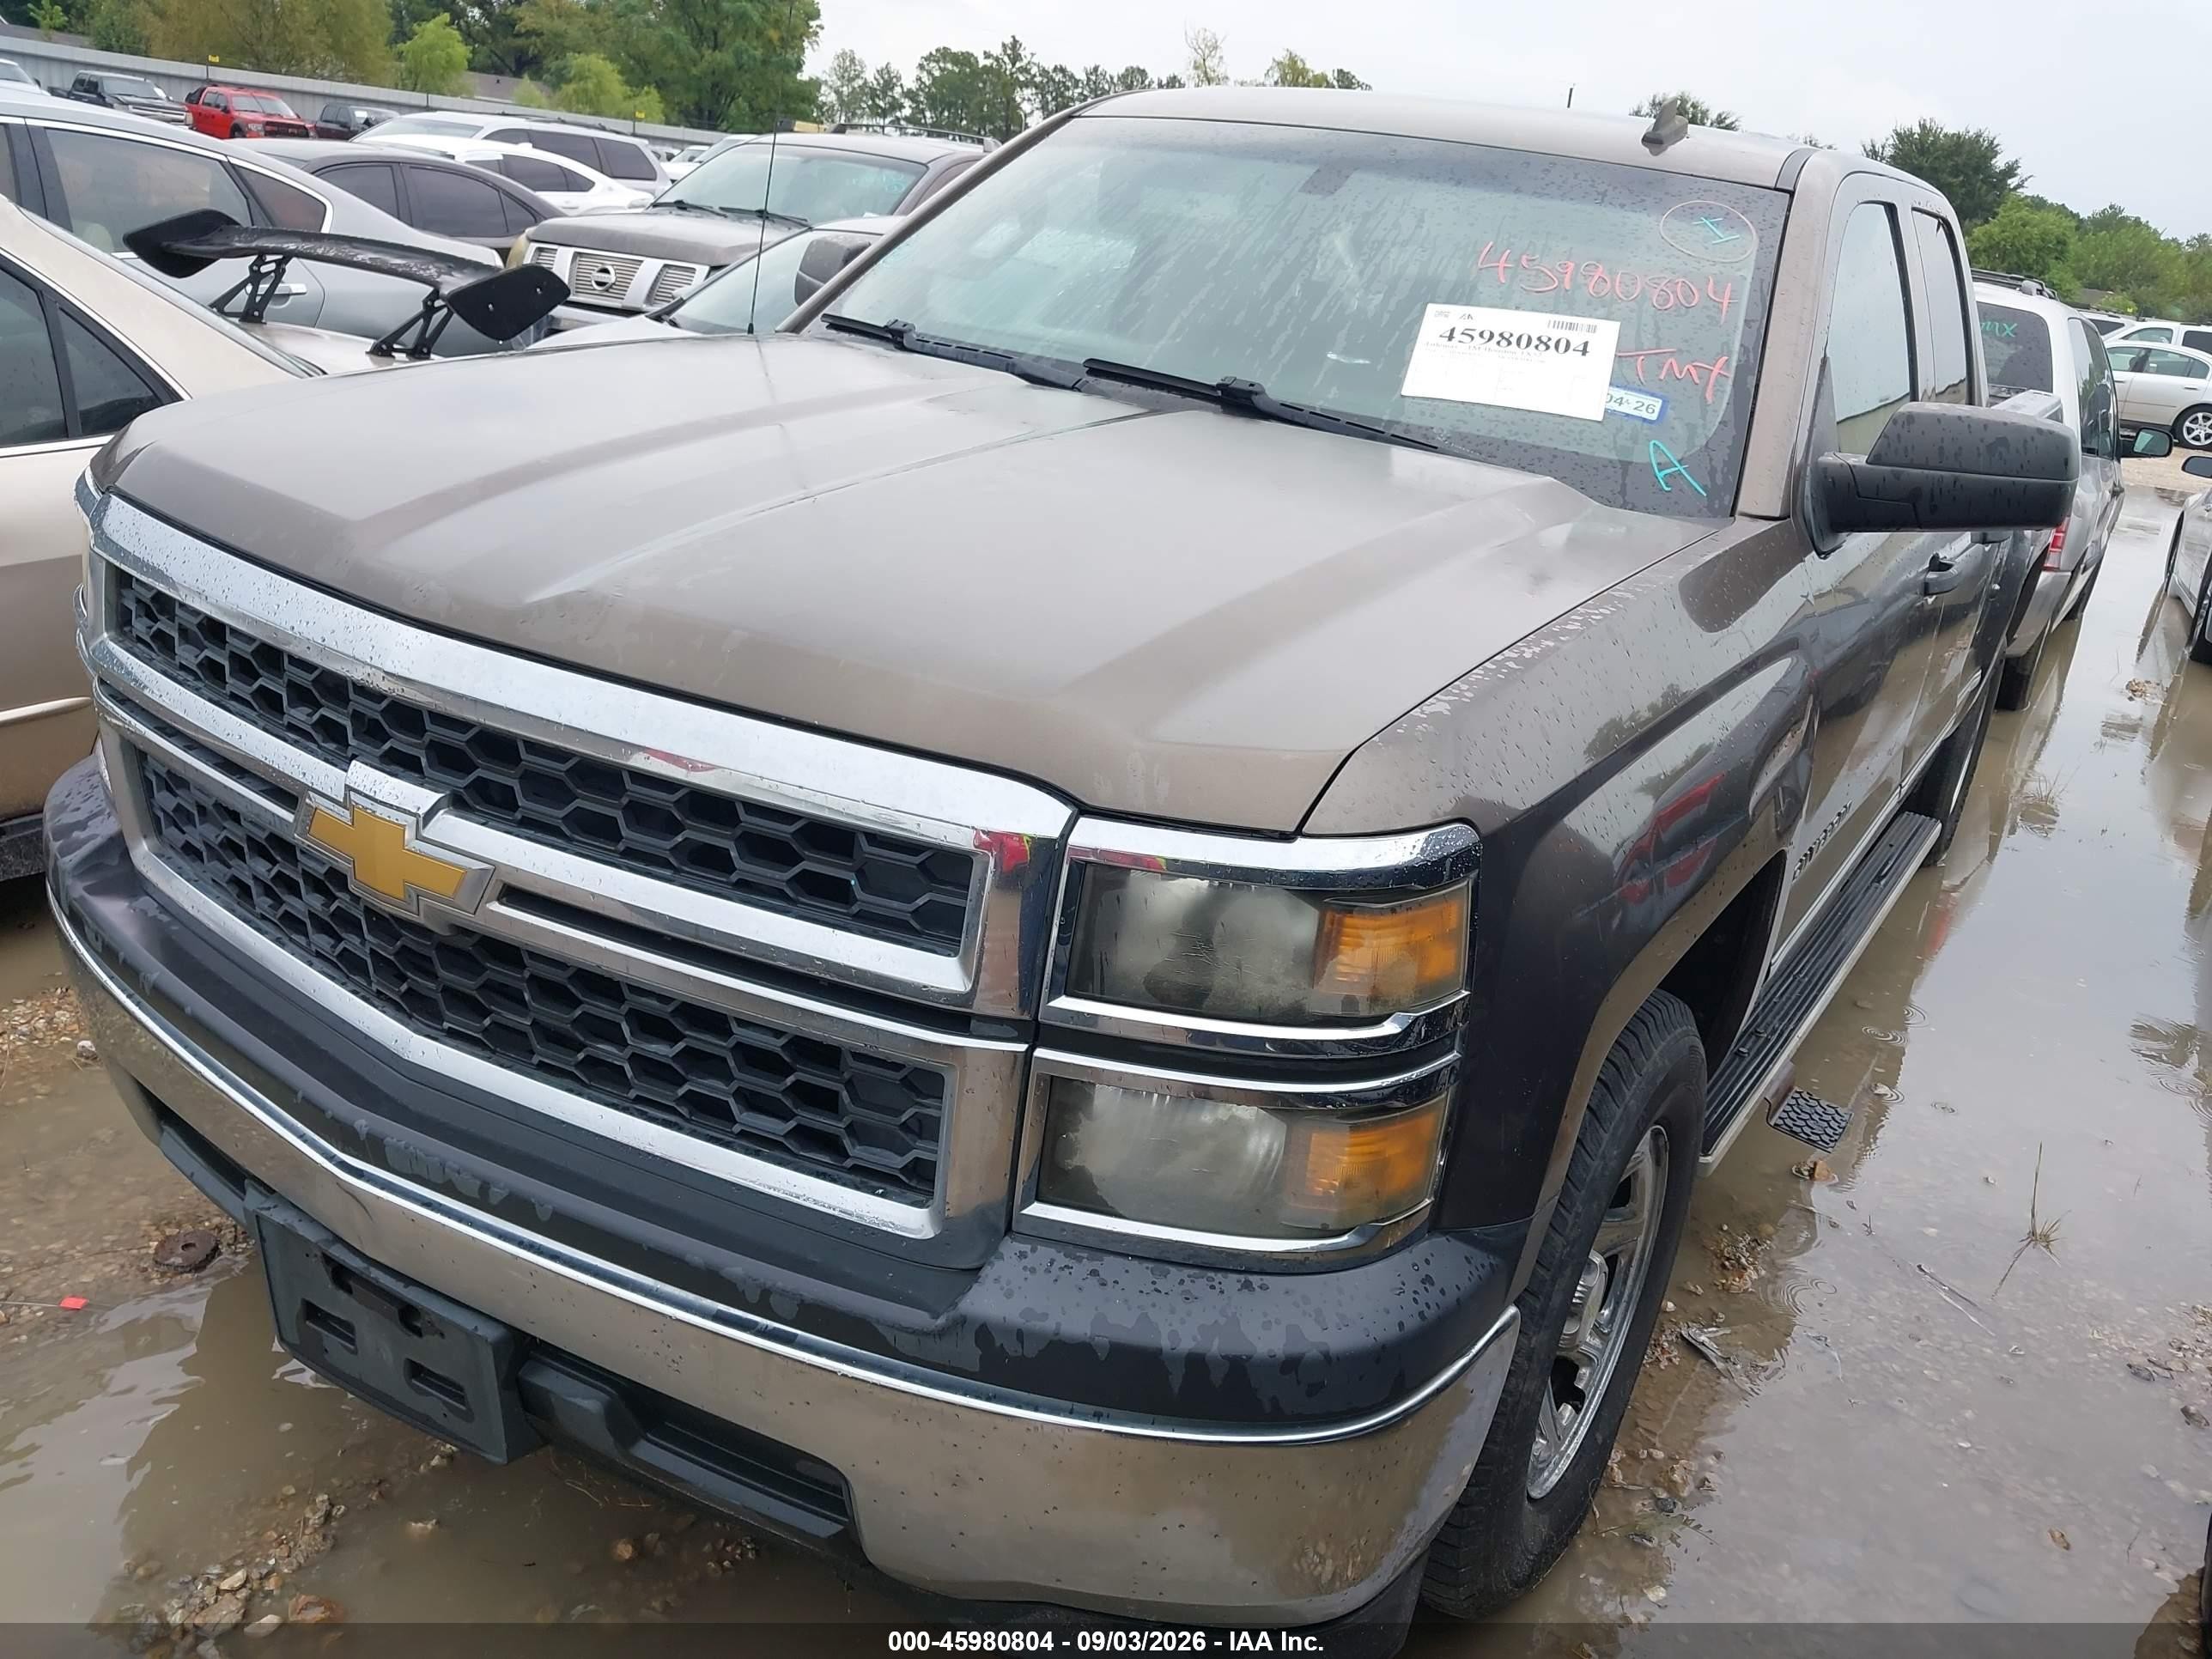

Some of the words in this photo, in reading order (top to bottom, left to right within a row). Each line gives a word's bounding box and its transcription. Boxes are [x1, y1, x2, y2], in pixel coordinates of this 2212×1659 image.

[1478, 240, 1739, 325] 45980804
[1438, 326, 1590, 357] 45980804
[1633, 400, 1656, 415] 26
[1649, 439, 1707, 497] A
